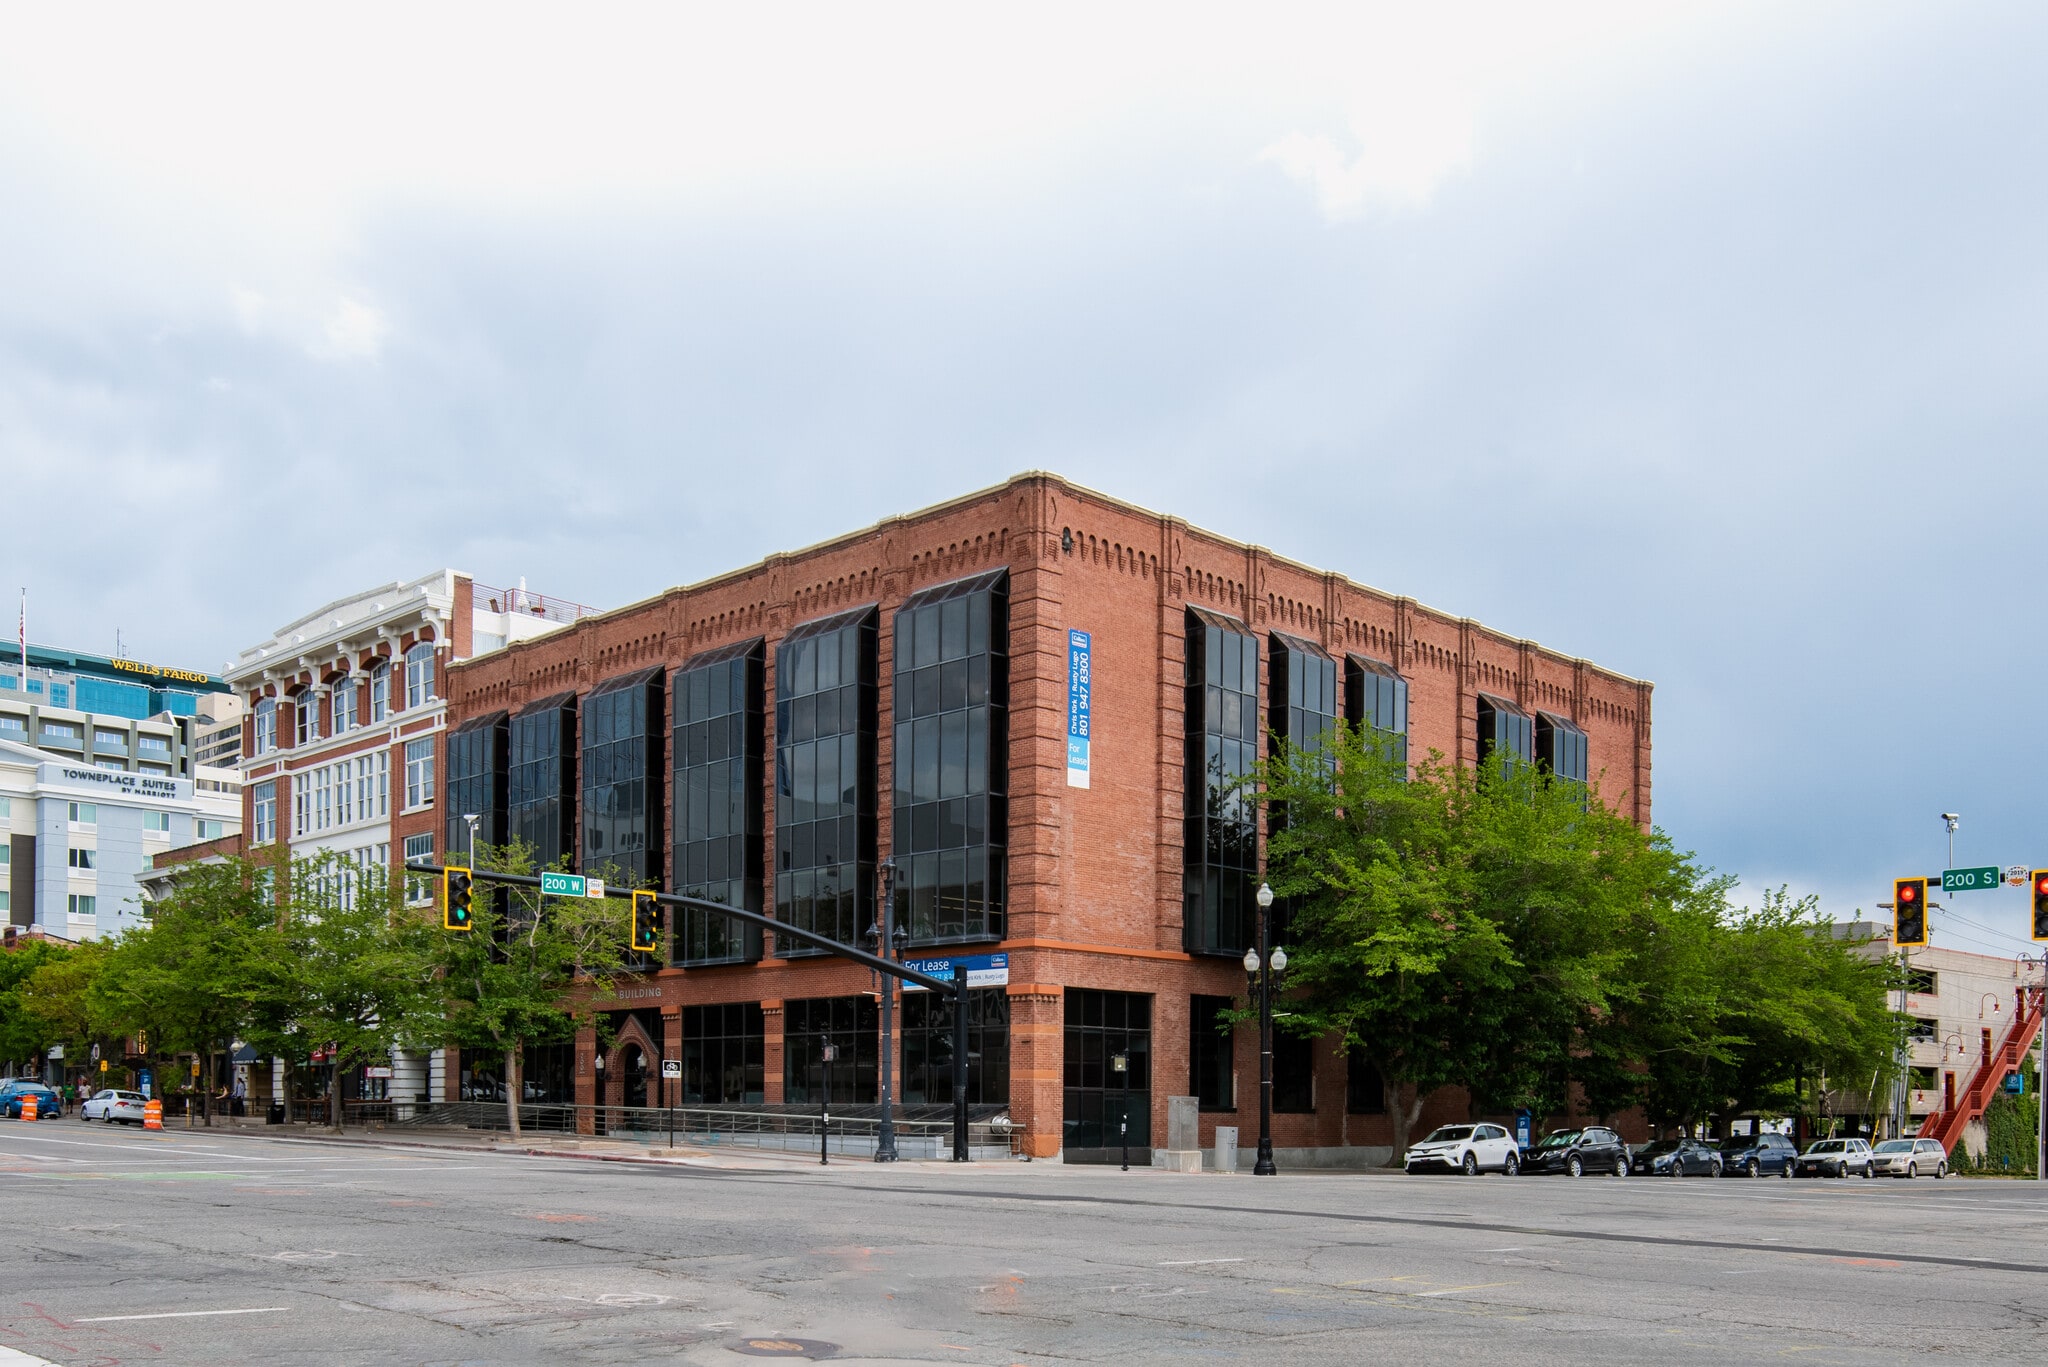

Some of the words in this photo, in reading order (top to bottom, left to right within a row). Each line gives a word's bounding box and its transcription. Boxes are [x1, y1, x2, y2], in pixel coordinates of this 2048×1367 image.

[1072, 651, 1080, 670] Lugo
[1079, 652, 1089, 685] 8300
[111, 659, 160, 676] WELLS
[162, 667, 208, 684] FARGO
[1071, 671, 1079, 692] Rusty
[1079, 685, 1089, 710] 947
[1079, 714, 1088, 736] 801
[1069, 743, 1080, 753] For
[1068, 754, 1087, 767] Lease
[63, 769, 136, 786] TOWNEPLACE
[142, 779, 176, 791] SUITES
[134, 789, 176, 798] MARRIOTT
[545, 878, 566, 889] 200
[1945, 873, 1975, 887] 200
[1983, 871, 1996, 884] S.
[905, 961, 920, 972] For
[922, 960, 950, 972] Lease
[620, 988, 661, 999] BUILDING
